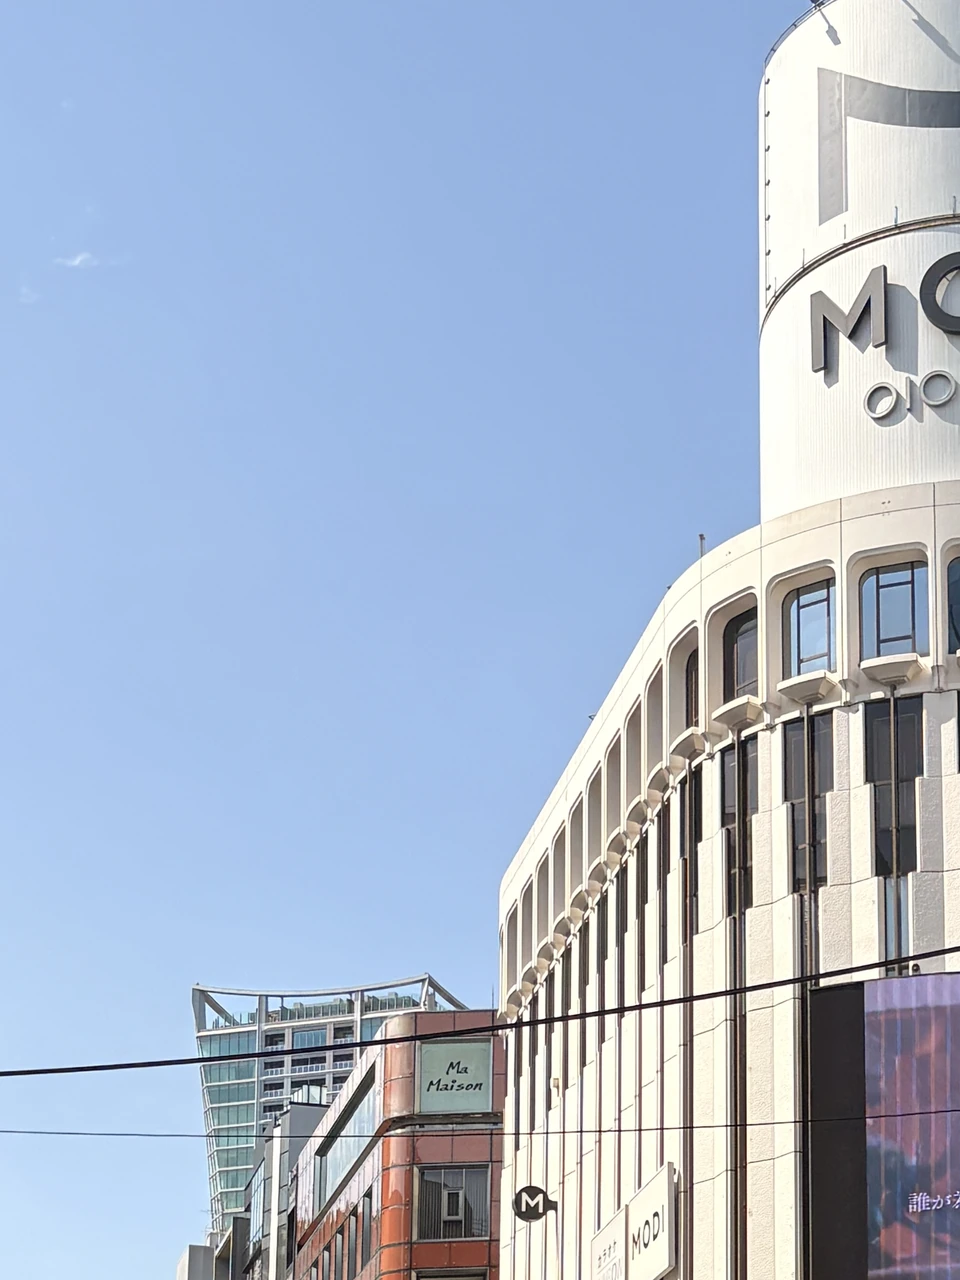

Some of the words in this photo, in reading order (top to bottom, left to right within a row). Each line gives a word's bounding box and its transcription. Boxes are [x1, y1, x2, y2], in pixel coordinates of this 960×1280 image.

[446, 1061, 468, 1075] Ma
[427, 1078, 483, 1092] Maison
[632, 1204, 664, 1260] MODI
